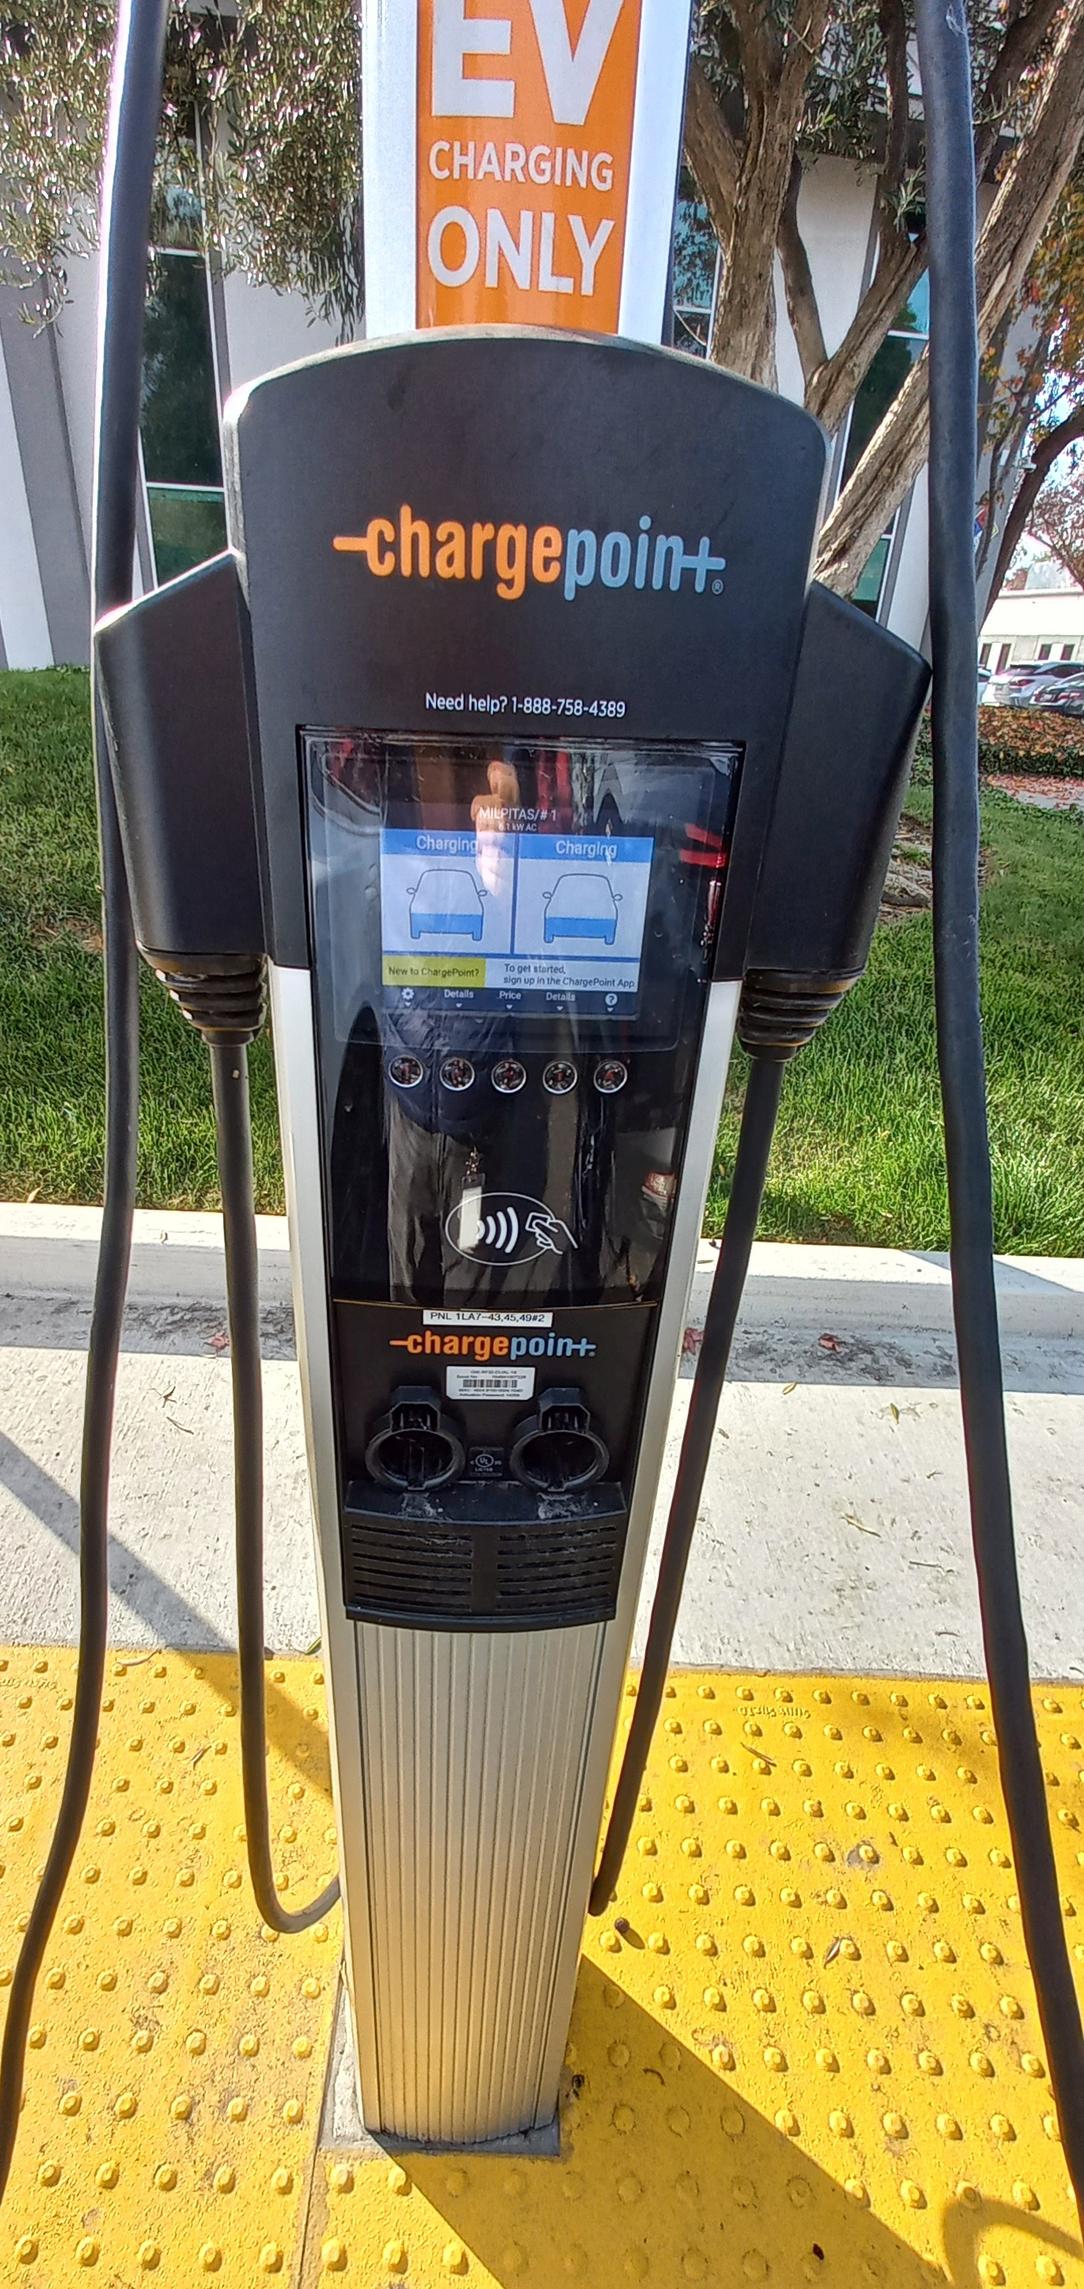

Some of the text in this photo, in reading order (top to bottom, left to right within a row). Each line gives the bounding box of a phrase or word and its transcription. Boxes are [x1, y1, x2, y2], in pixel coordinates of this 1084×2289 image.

[430, 0, 625, 126] EV
[428, 140, 614, 192] CHARGING
[427, 205, 615, 297] ONLY
[425, 692, 626, 718] Need help? 1-888-758-4389
[512, 823, 525, 832] kW
[525, 823, 538, 832] AC
[416, 835, 479, 855] Charging
[555, 840, 618, 858] Charging
[388, 966, 480, 979] New to ChargePoint?
[504, 963, 515, 973] To
[517, 964, 531, 976] get
[503, 975, 636, 990] sign up in the ChargePoint App
[444, 988, 474, 999] Details
[500, 991, 522, 1000] Price
[546, 991, 576, 1002] Details
[430, 1312, 453, 1321] PNL
